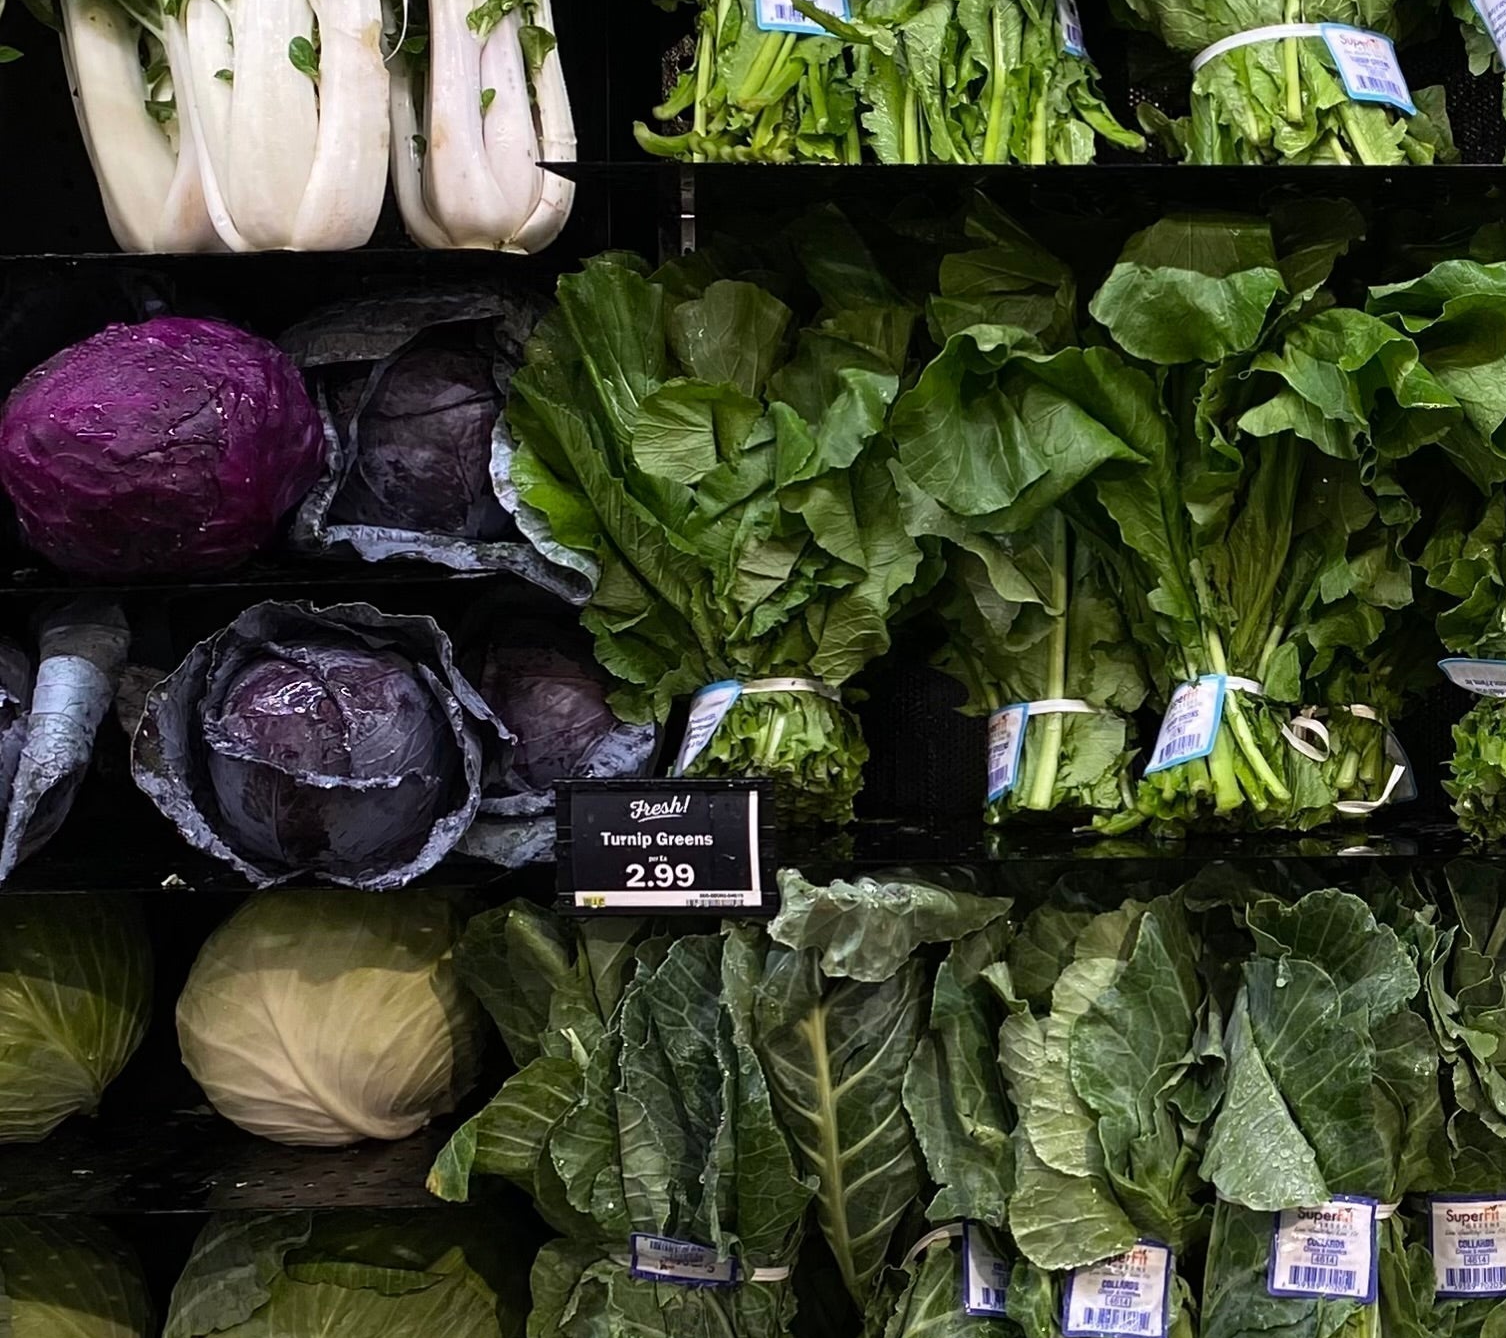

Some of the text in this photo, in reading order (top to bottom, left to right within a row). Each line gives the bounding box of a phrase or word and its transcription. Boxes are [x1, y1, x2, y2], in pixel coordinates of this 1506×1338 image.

[630, 795, 691, 819] Fresh!
[601, 832, 713, 848] Turnip Greens
[625, 864, 694, 887] 2.99
[1446, 1207, 1500, 1226] SuperFit
[1458, 1239, 1494, 1248] COLLARDS
